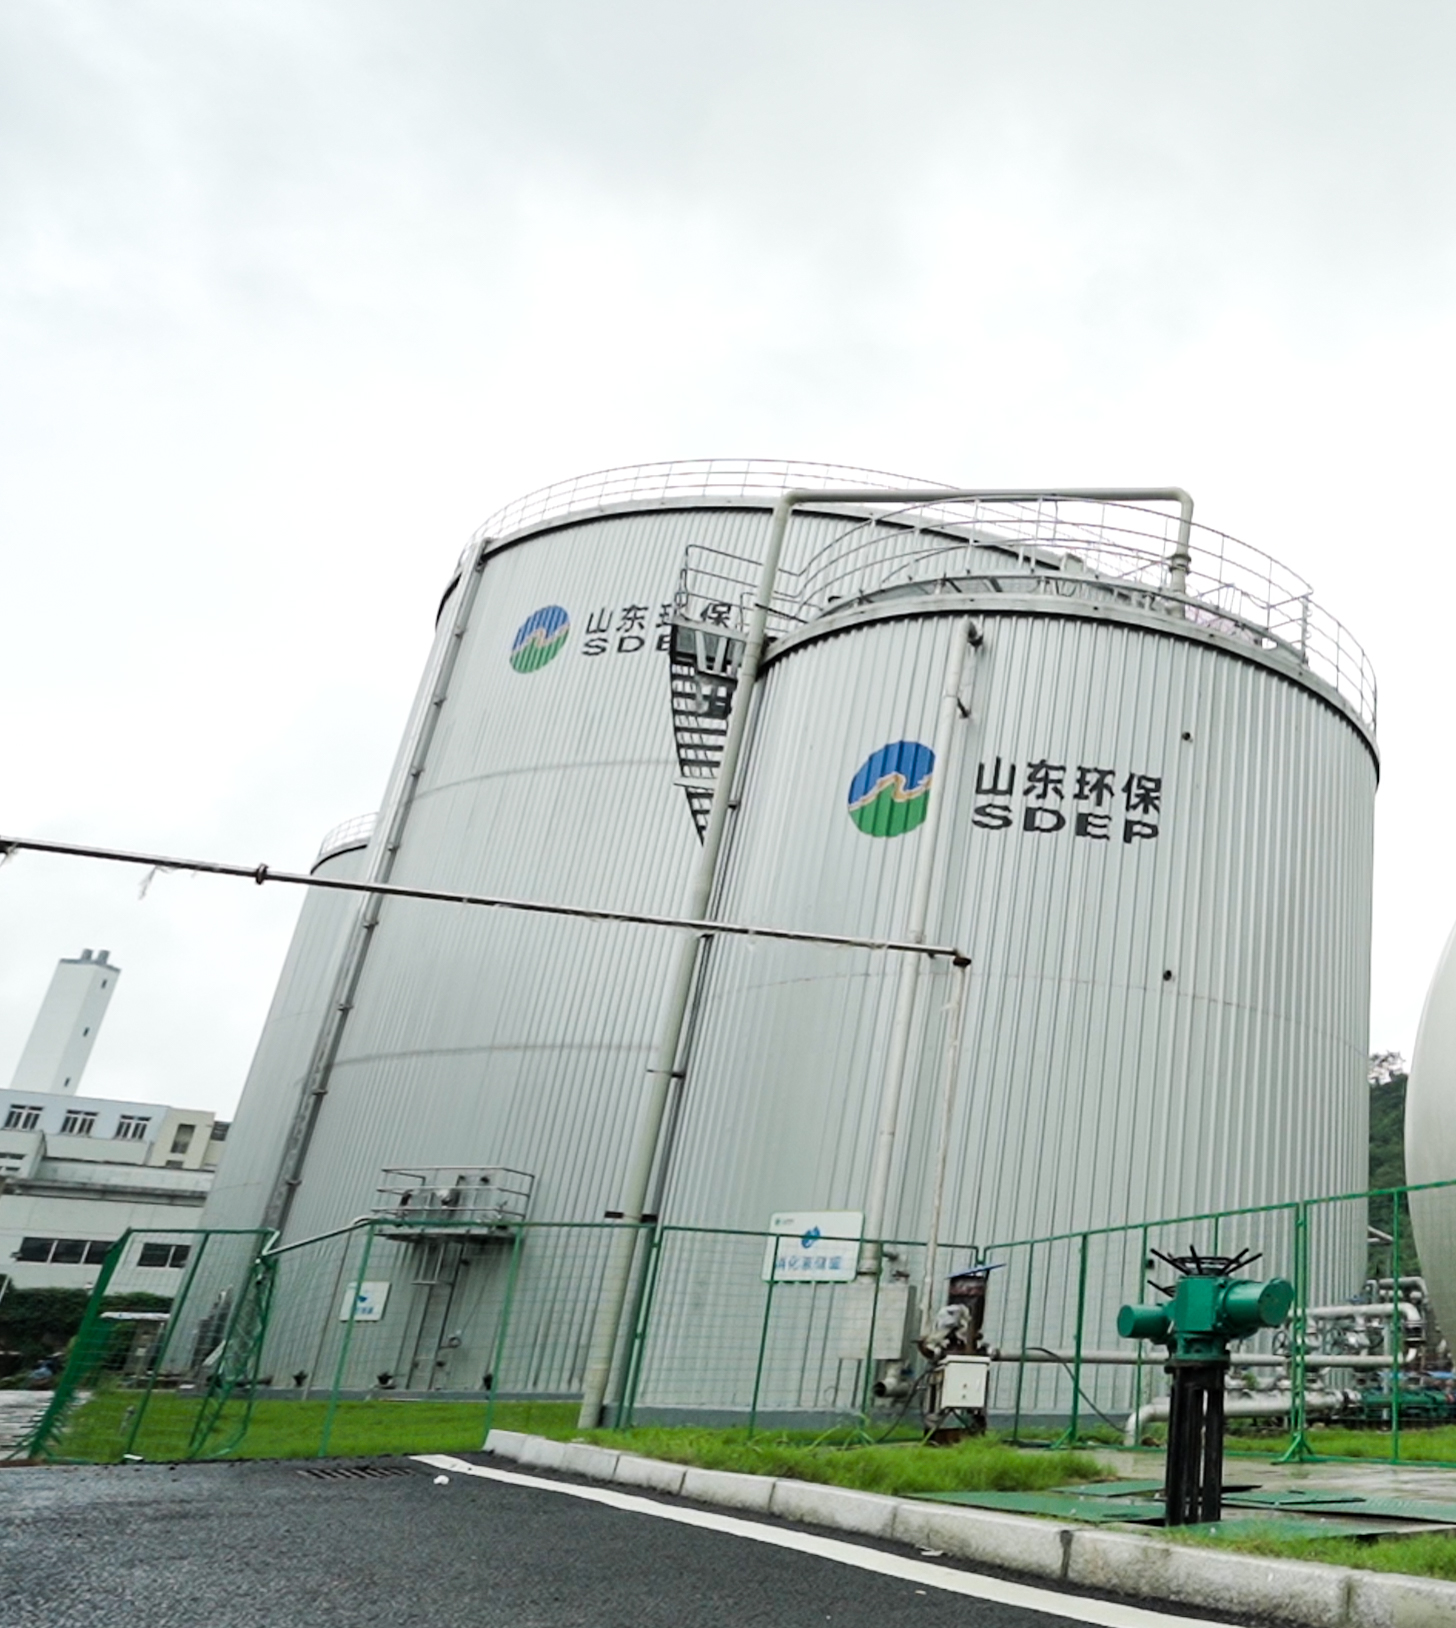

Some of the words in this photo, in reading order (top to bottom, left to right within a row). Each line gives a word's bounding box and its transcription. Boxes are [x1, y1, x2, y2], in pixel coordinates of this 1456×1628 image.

[582, 634, 672, 656] SDE
[975, 756, 1162, 815] 山东环保
[972, 803, 1159, 844] SDEP
